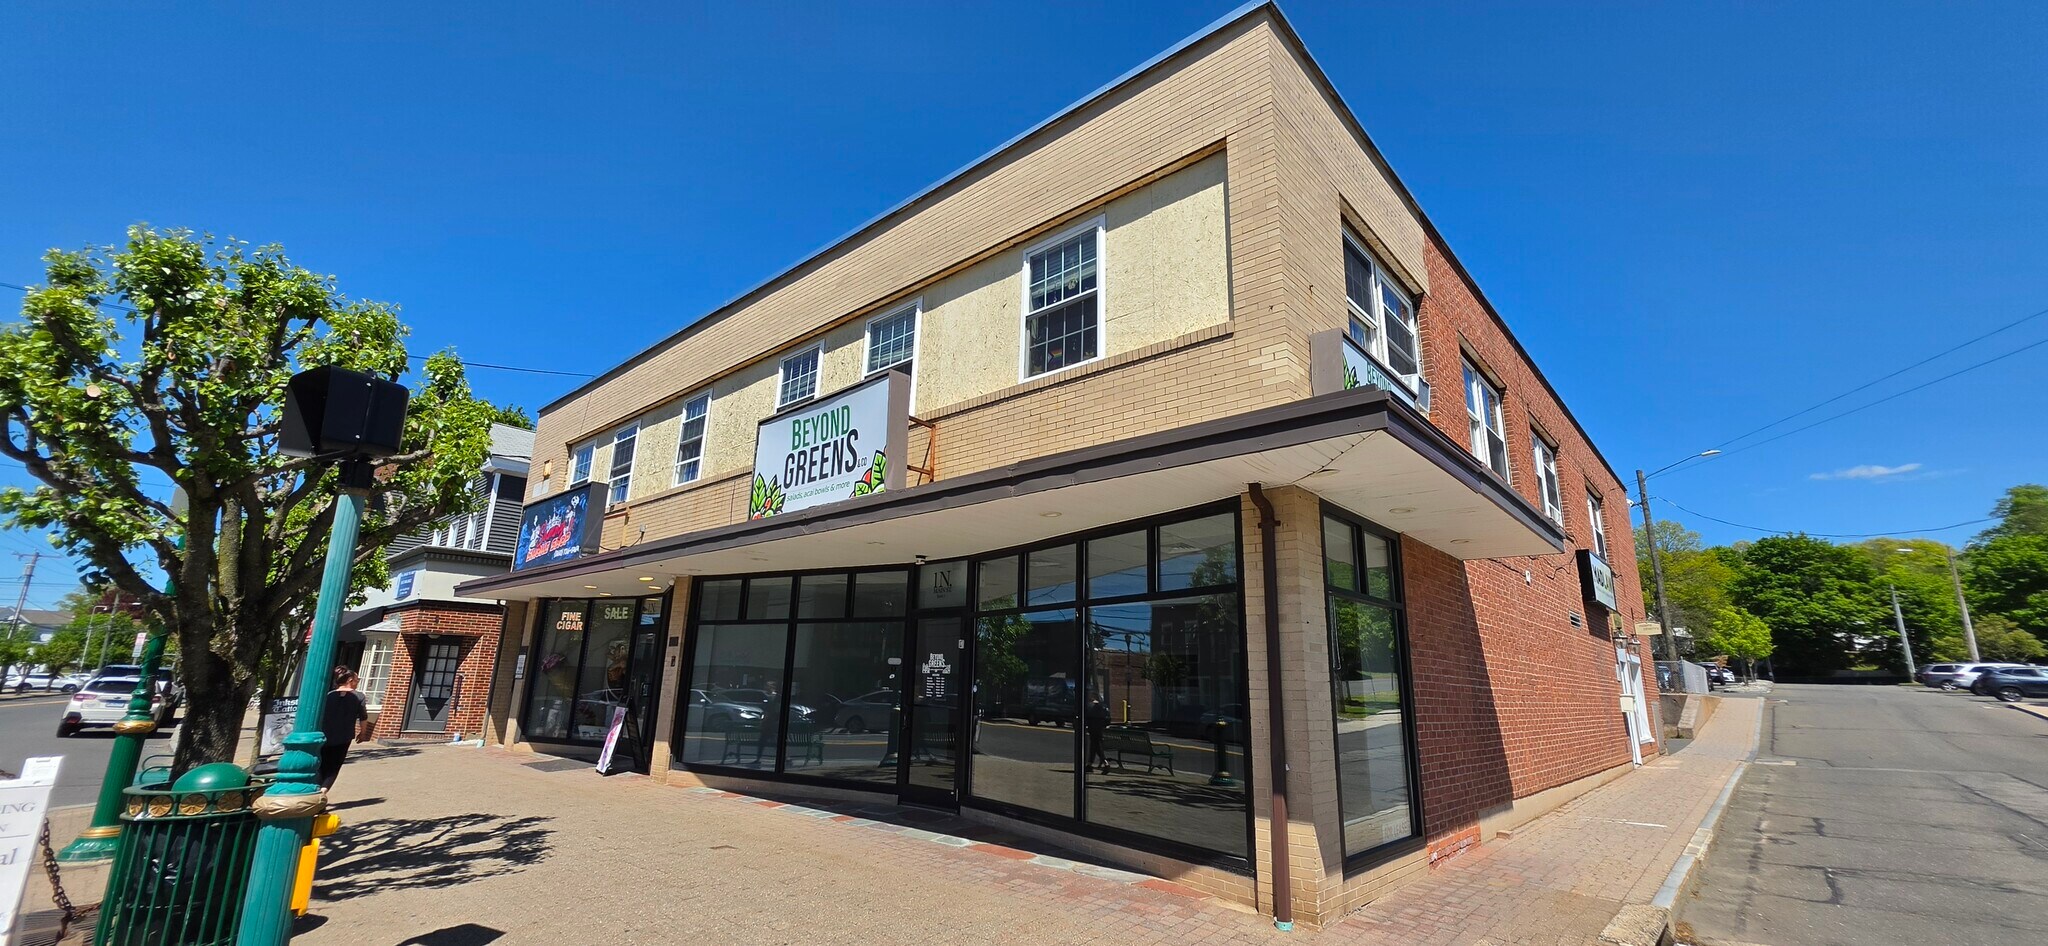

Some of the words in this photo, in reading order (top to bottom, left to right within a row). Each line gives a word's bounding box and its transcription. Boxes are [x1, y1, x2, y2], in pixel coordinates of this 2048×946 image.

[792, 405, 851, 451] BEYOND
[783, 428, 859, 490] GREENS
[814, 485, 830, 495] bowls
[836, 481, 851, 490] more
[561, 612, 582, 621] FINE
[604, 607, 629, 620] SALE
[556, 621, 583, 631] CIGAR
[272, 705, 298, 713] Tatto
[0, 802, 35, 815] ING
